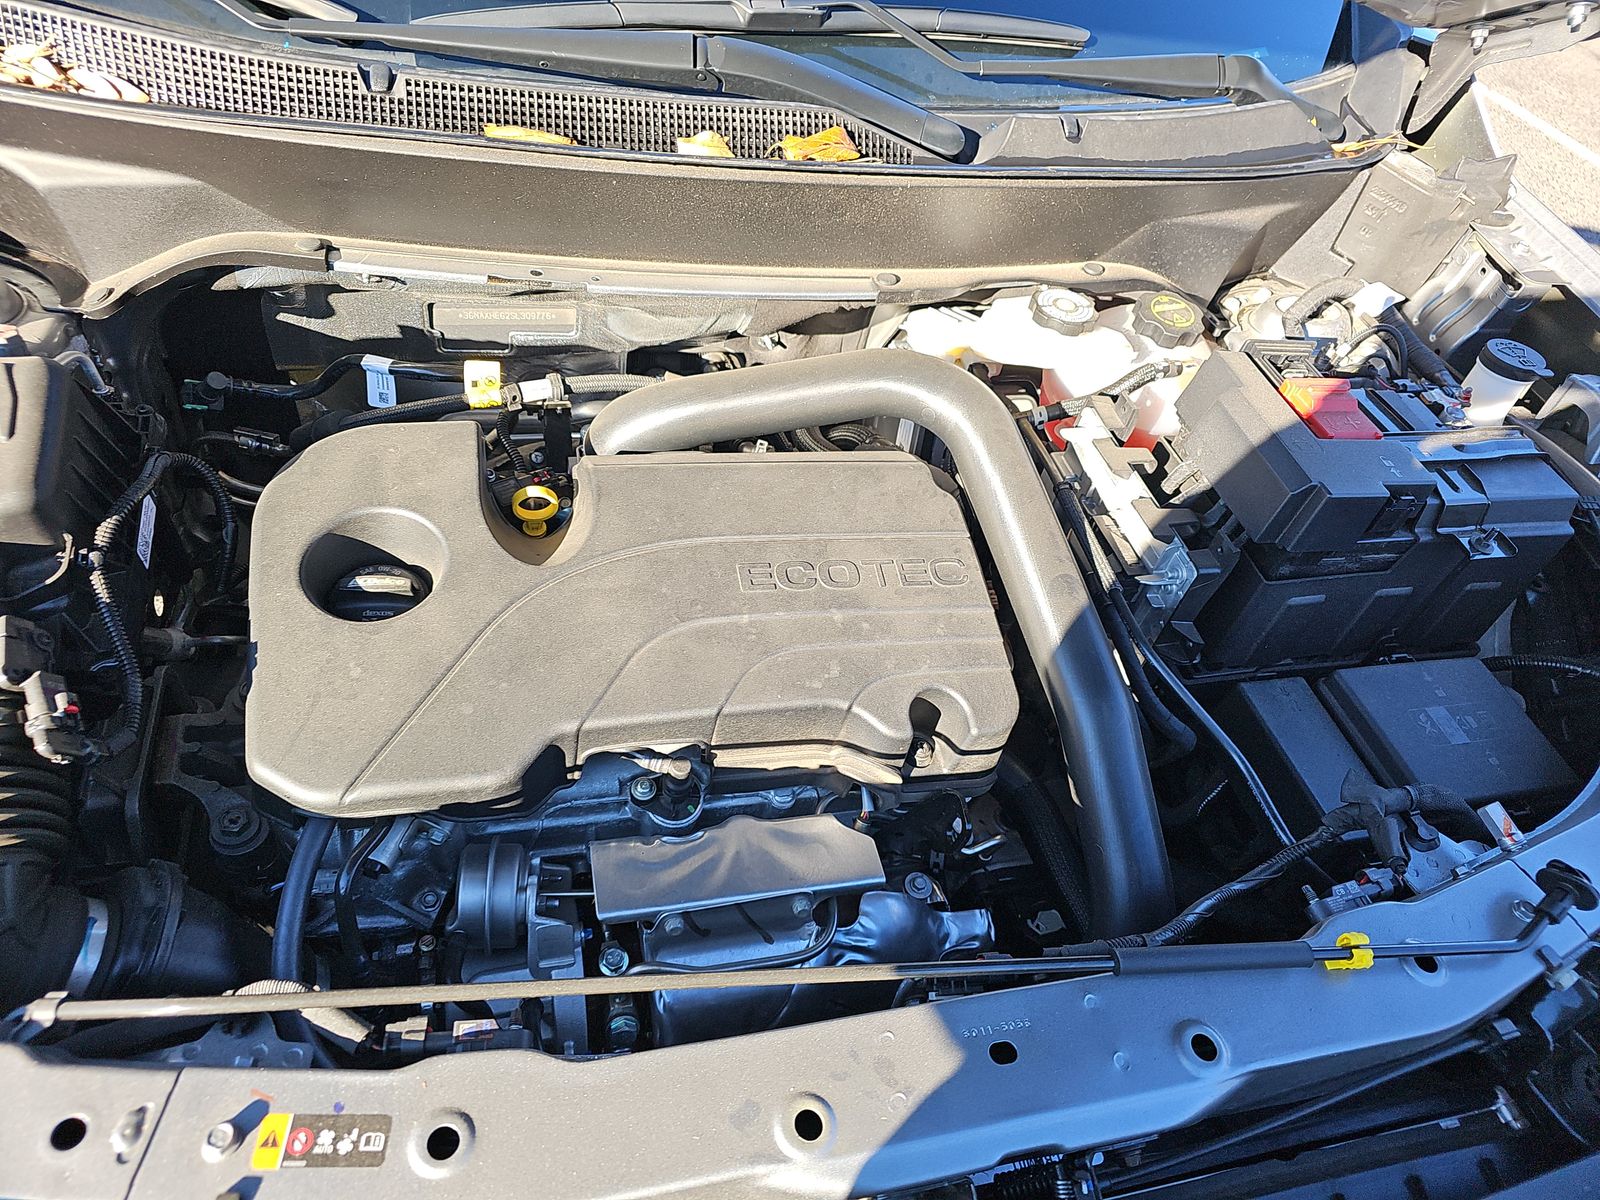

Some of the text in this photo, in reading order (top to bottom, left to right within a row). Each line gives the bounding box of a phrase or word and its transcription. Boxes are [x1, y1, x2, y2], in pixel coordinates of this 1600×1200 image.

[736, 557, 969, 593] ECOTEC
[362, 609, 395, 617] dexos
[312, 1144, 335, 1155] AUTO
